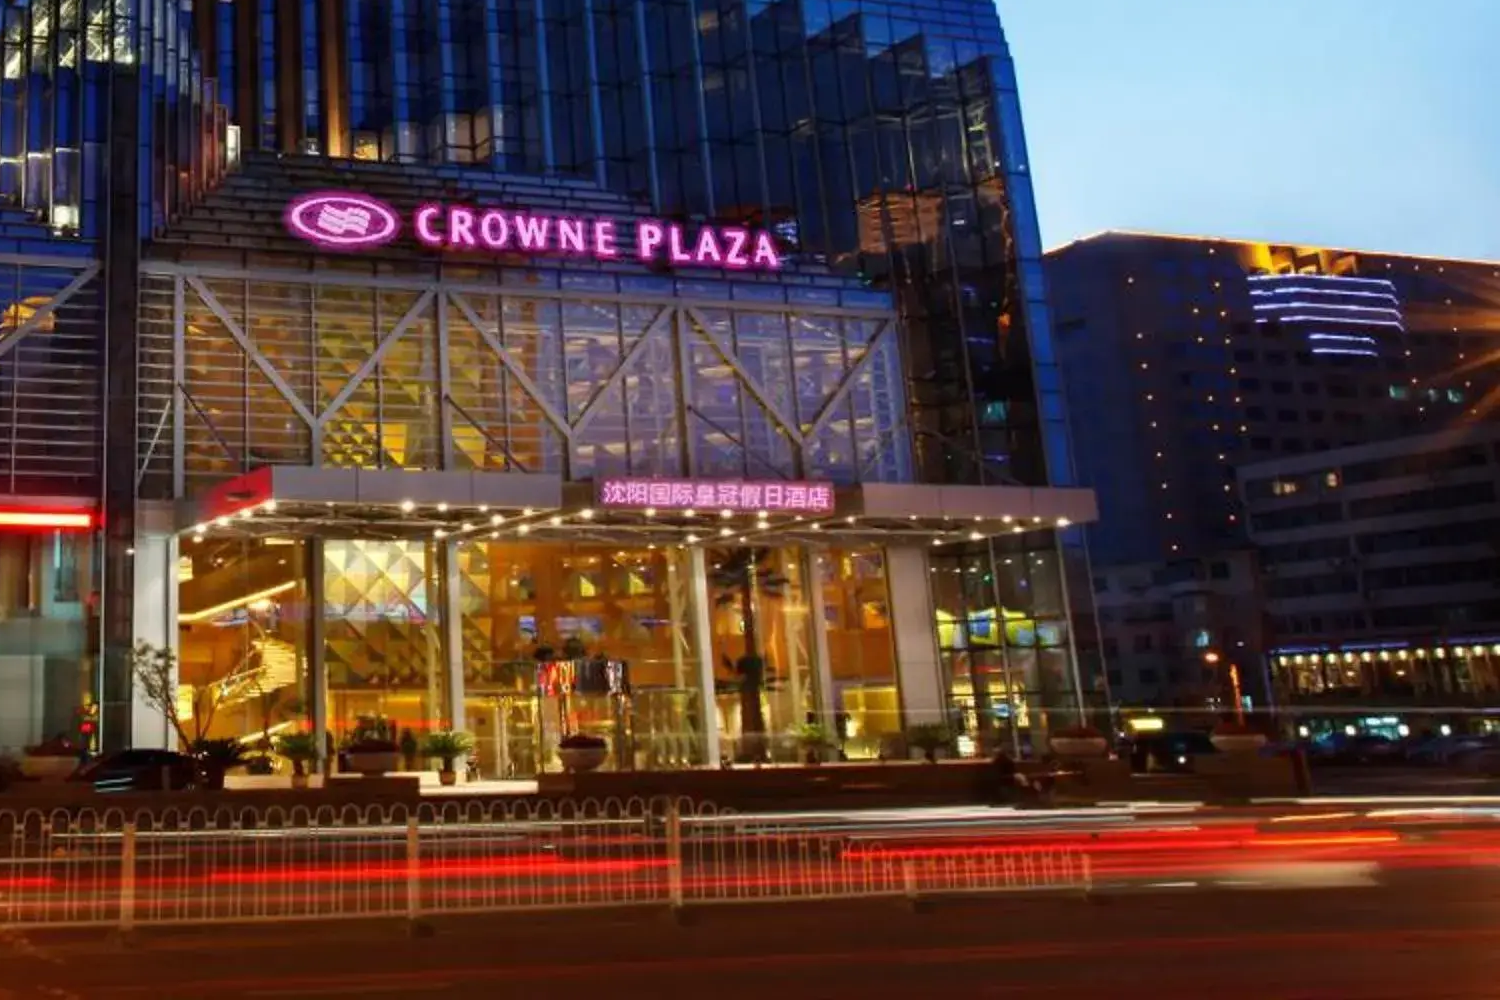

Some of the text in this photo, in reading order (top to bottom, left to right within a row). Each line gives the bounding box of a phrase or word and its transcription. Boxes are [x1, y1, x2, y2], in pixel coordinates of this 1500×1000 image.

[415, 206, 780, 267] CROWNE PLAZA
[602, 481, 831, 510] 沈阳国际皇冠假日酒店
